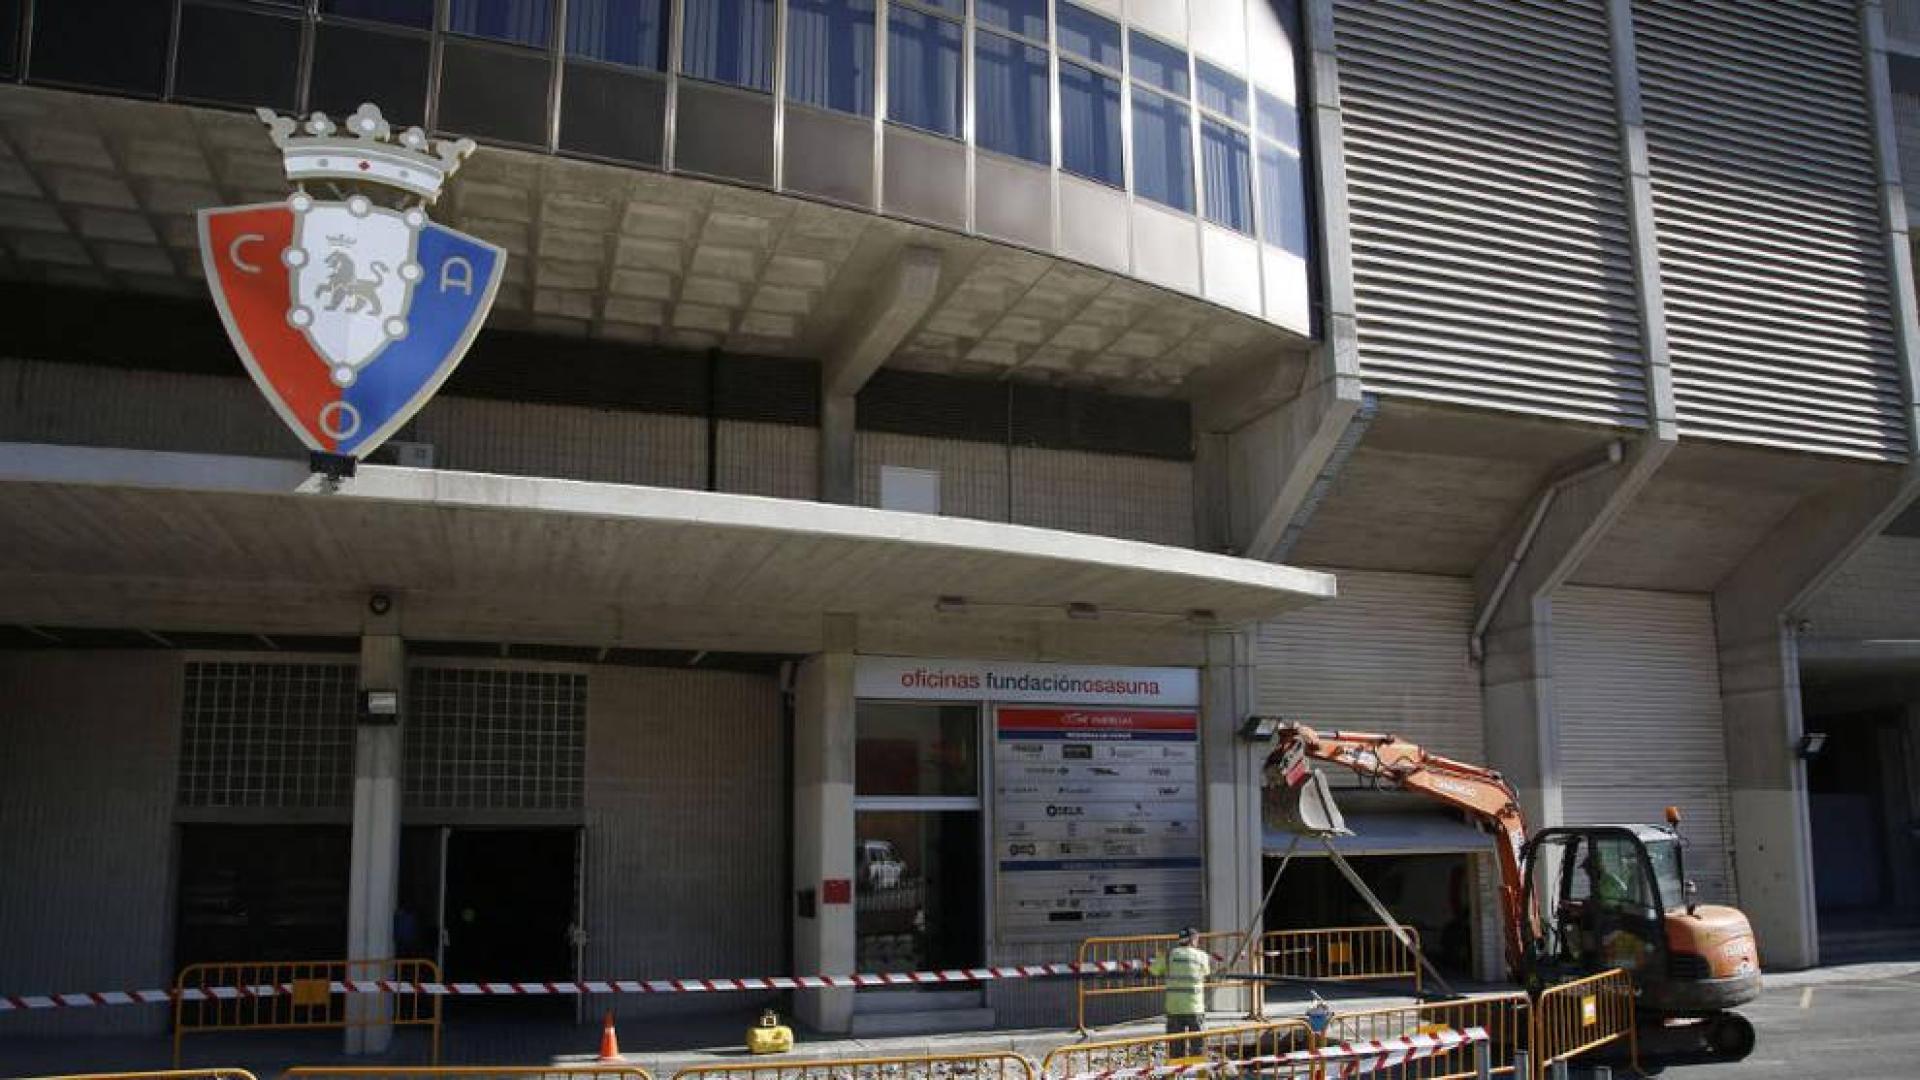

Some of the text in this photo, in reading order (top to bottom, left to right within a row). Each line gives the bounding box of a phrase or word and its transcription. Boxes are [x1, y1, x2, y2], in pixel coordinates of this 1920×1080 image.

[230, 234, 472, 295] C A
[319, 400, 361, 440] O
[901, 668, 980, 690] oficinas
